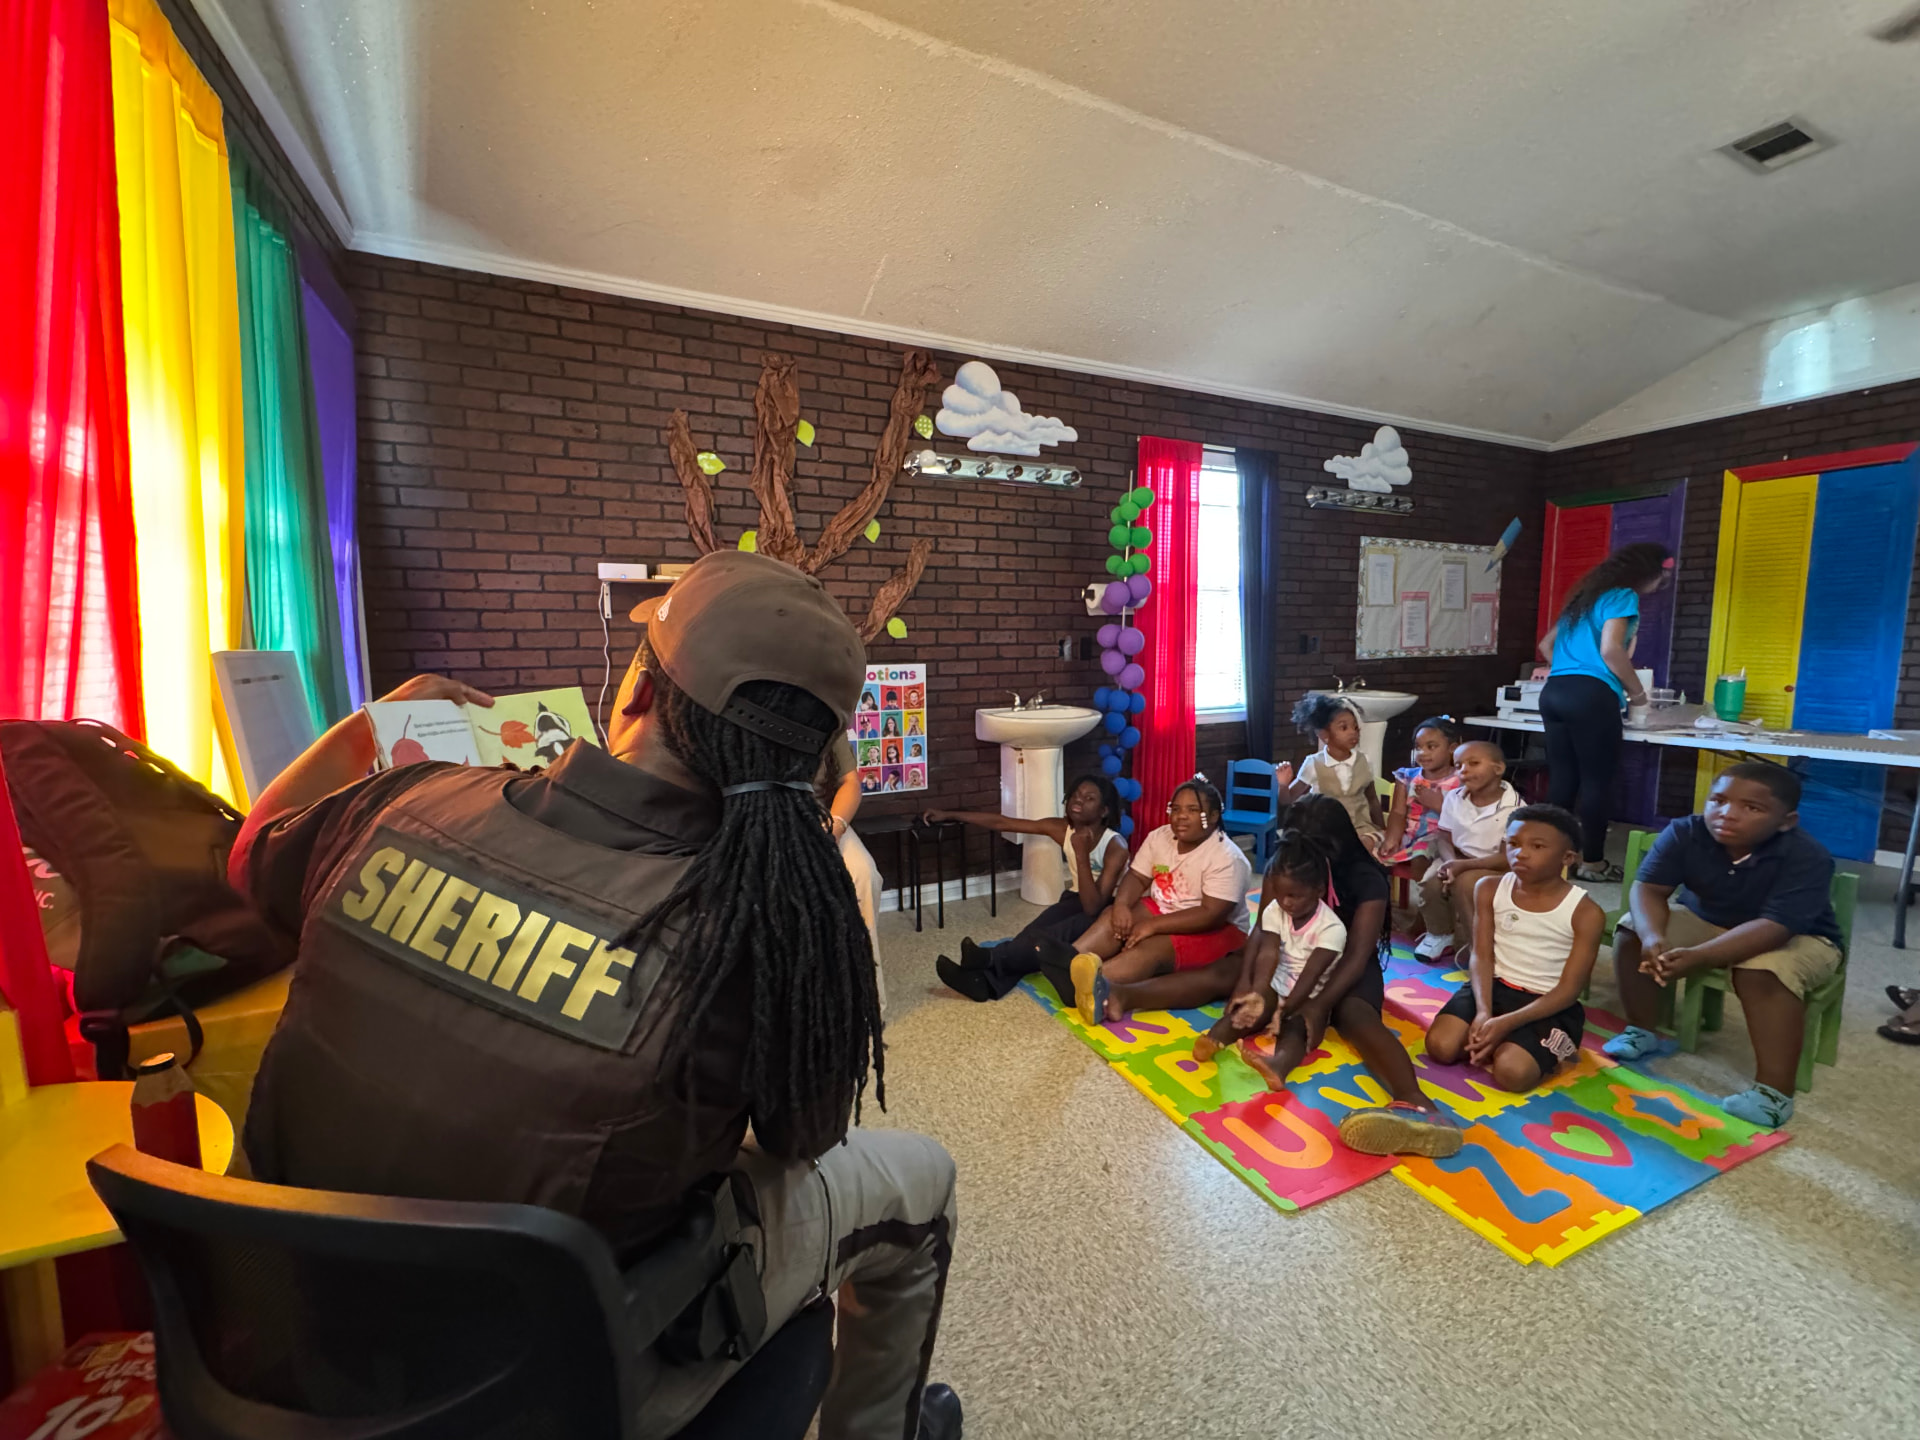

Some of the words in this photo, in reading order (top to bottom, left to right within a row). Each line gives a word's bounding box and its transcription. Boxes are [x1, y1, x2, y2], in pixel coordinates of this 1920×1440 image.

[867, 667, 916, 681] otions
[342, 847, 638, 1021] SHERIFF
[1222, 1103, 1334, 1170] U
[1433, 1143, 1572, 1224] Z
[25, 1395, 124, 1440] 10
